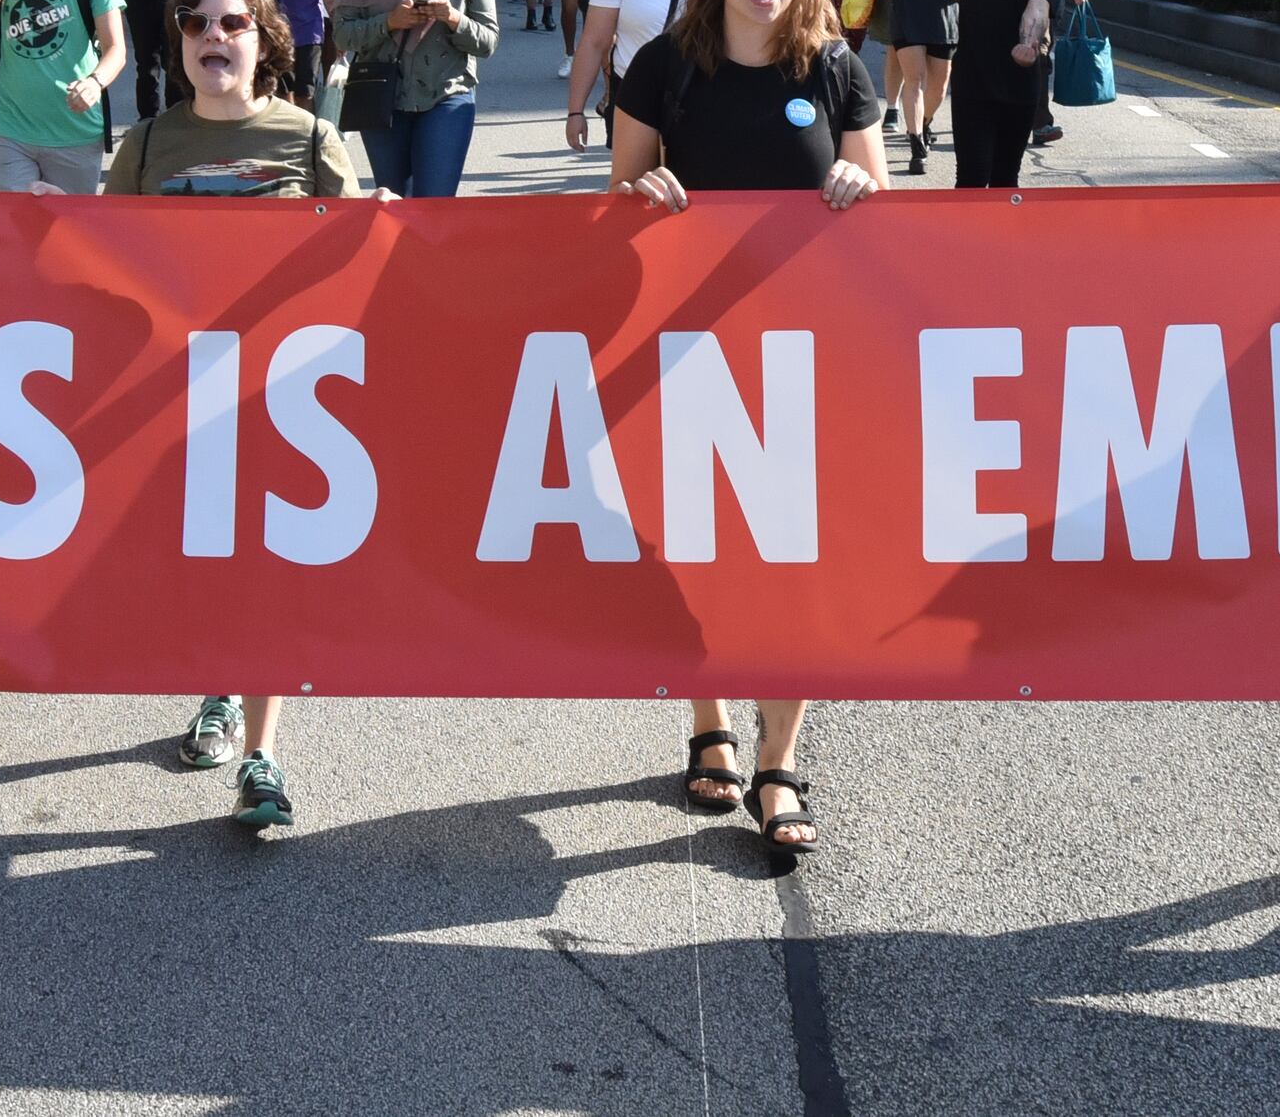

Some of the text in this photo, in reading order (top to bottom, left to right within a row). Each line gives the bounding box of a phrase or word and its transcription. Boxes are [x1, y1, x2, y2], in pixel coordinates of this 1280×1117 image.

[6, 4, 70, 42] OVE CREW
[182, 324, 379, 566] IS
[476, 330, 820, 564] AN
